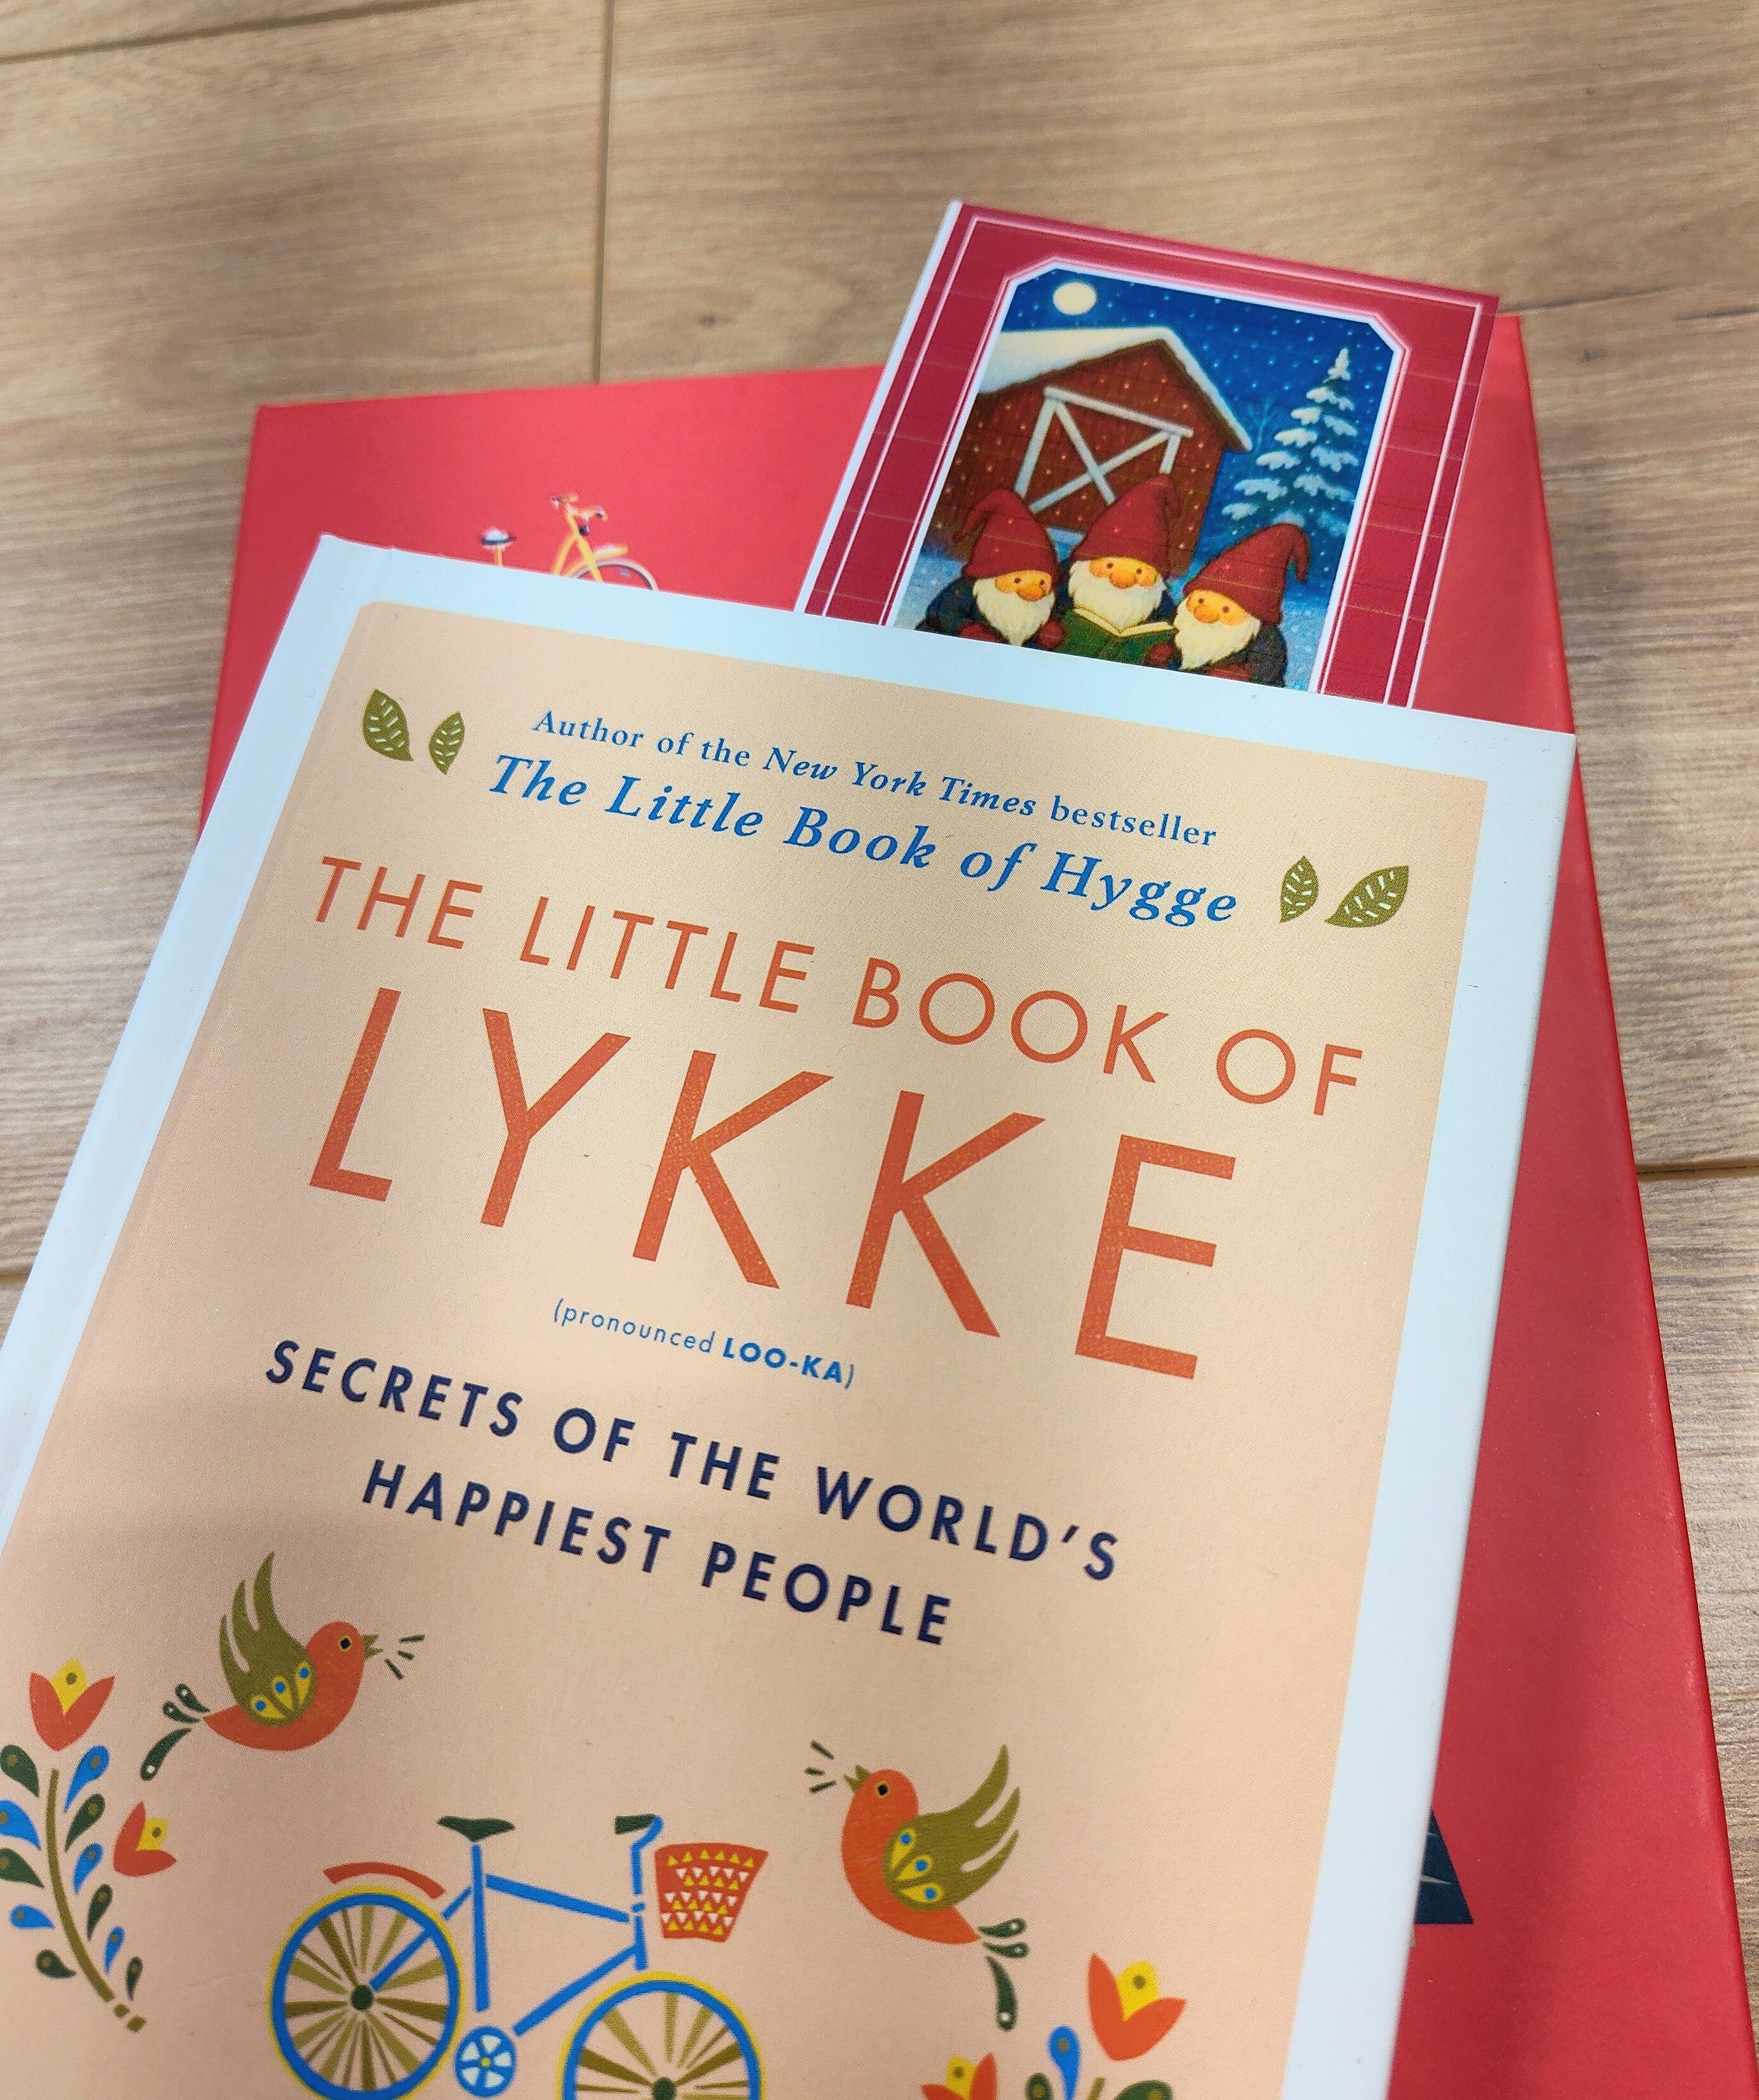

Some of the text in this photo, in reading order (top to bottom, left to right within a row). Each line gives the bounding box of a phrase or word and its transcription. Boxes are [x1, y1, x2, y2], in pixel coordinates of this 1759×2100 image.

[489, 754, 1236, 927] The Little Book of Hygge
[532, 710, 1217, 846] Author of the New York Times bestseller
[315, 856, 1363, 1116] THE LITTLE BOOK OF
[309, 987, 1236, 1379] LYKKE
[554, 1299, 854, 1389] (pronounced LOO-KA)
[265, 1340, 1118, 1581] SECRETS OF THE WORLD'S
[362, 1459, 951, 1646] HAPPIEST PEOPLE
